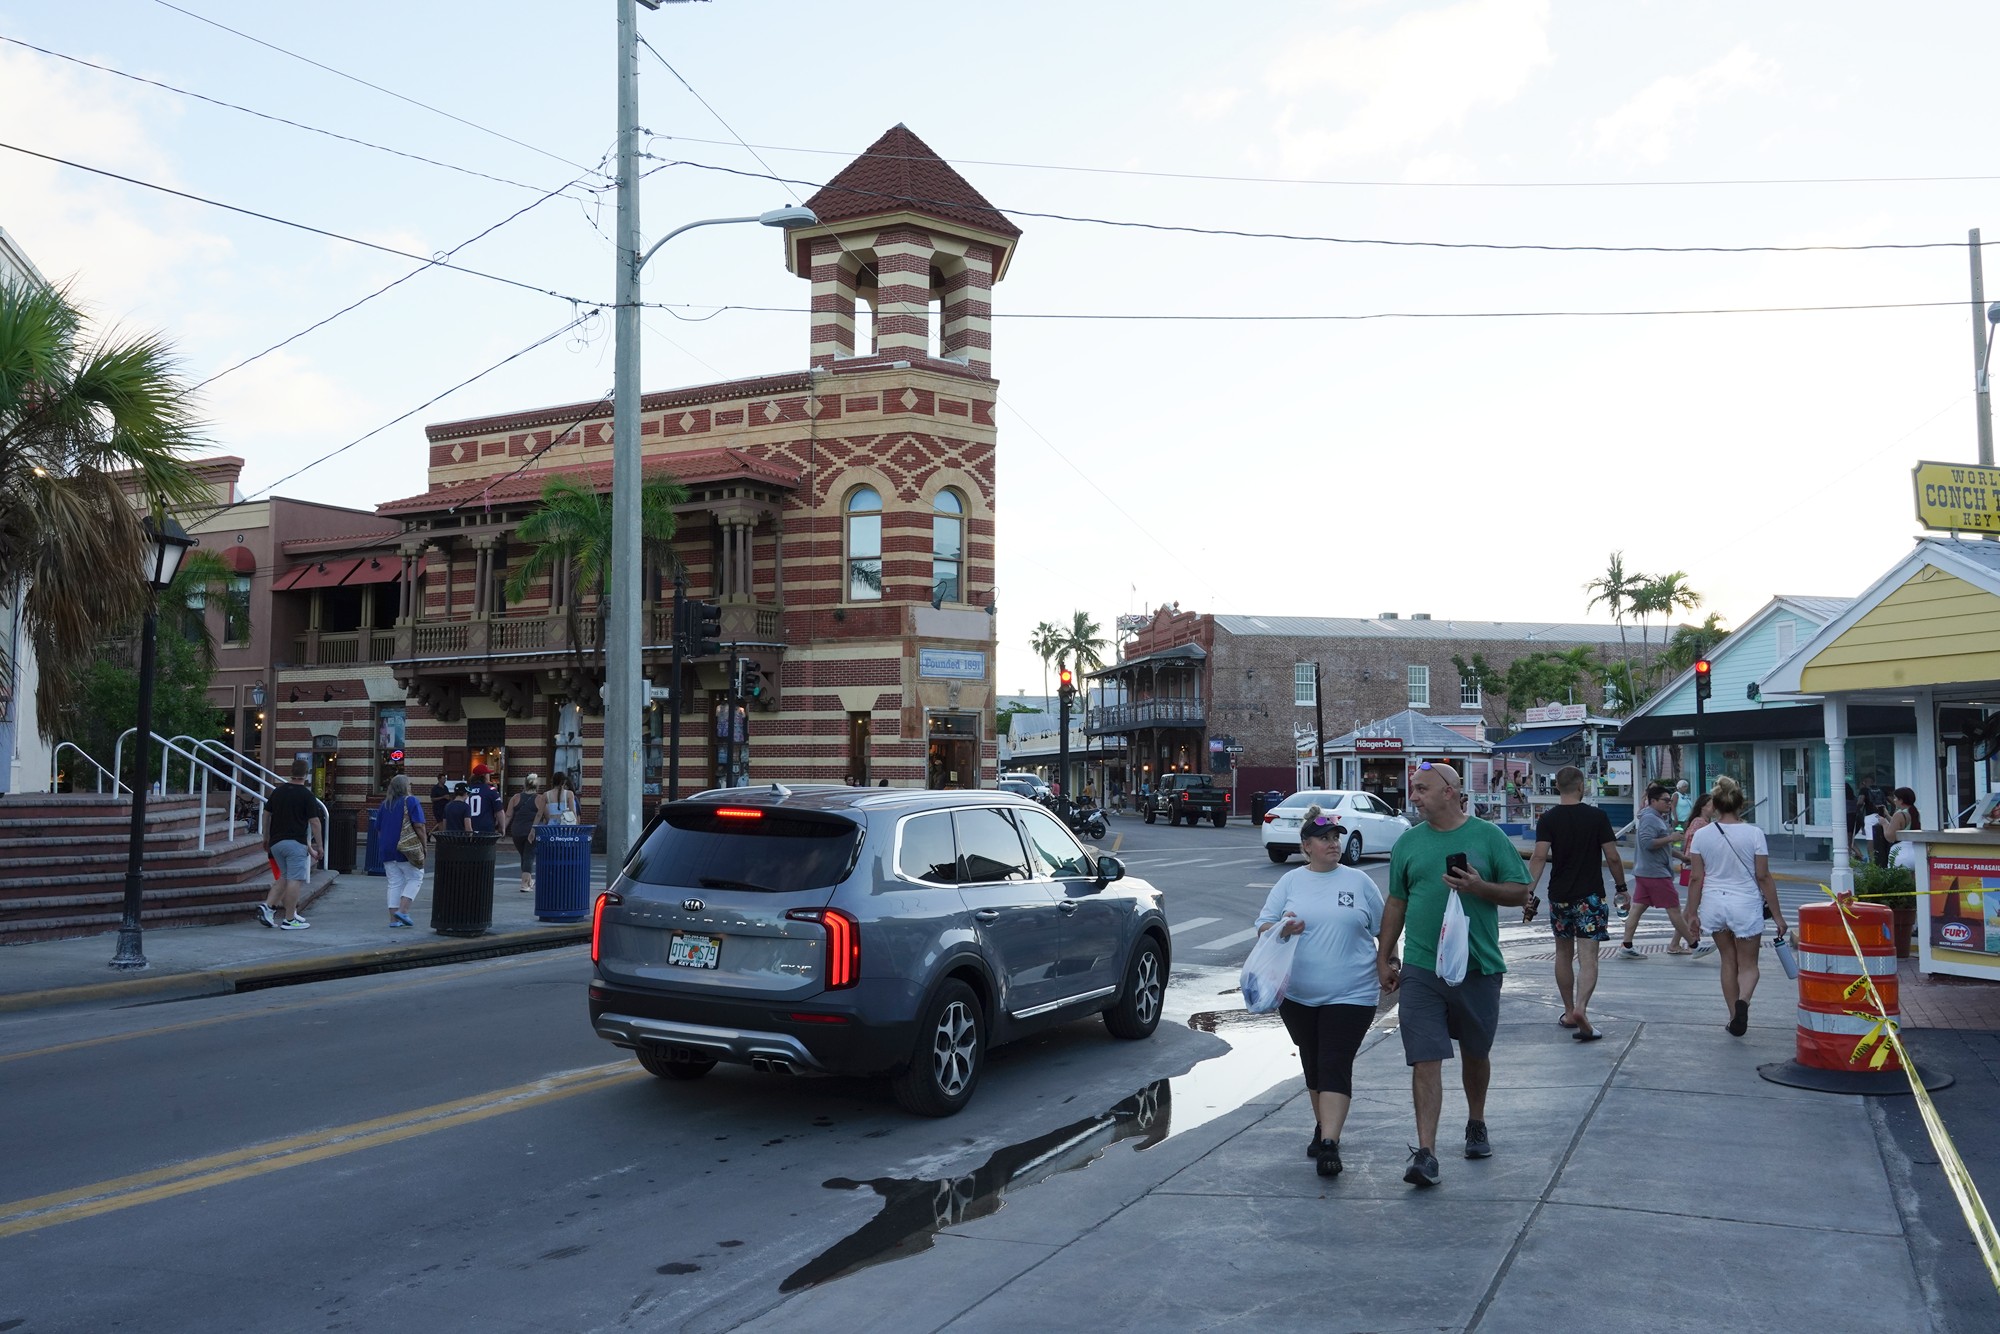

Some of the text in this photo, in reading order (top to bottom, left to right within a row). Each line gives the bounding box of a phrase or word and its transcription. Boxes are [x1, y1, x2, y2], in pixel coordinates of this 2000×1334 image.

[1951, 469, 2000, 486] WORL
[1926, 484, 1987, 511] CONCH
[1963, 512, 1991, 527] KEY
[924, 658, 980, 670] Founded 1891
[1356, 740, 1401, 750] Häagen-Dazs
[1933, 862, 1953, 870] SUNSET
[684, 901, 701, 910] KIA
[1944, 928, 1968, 938] FURY
